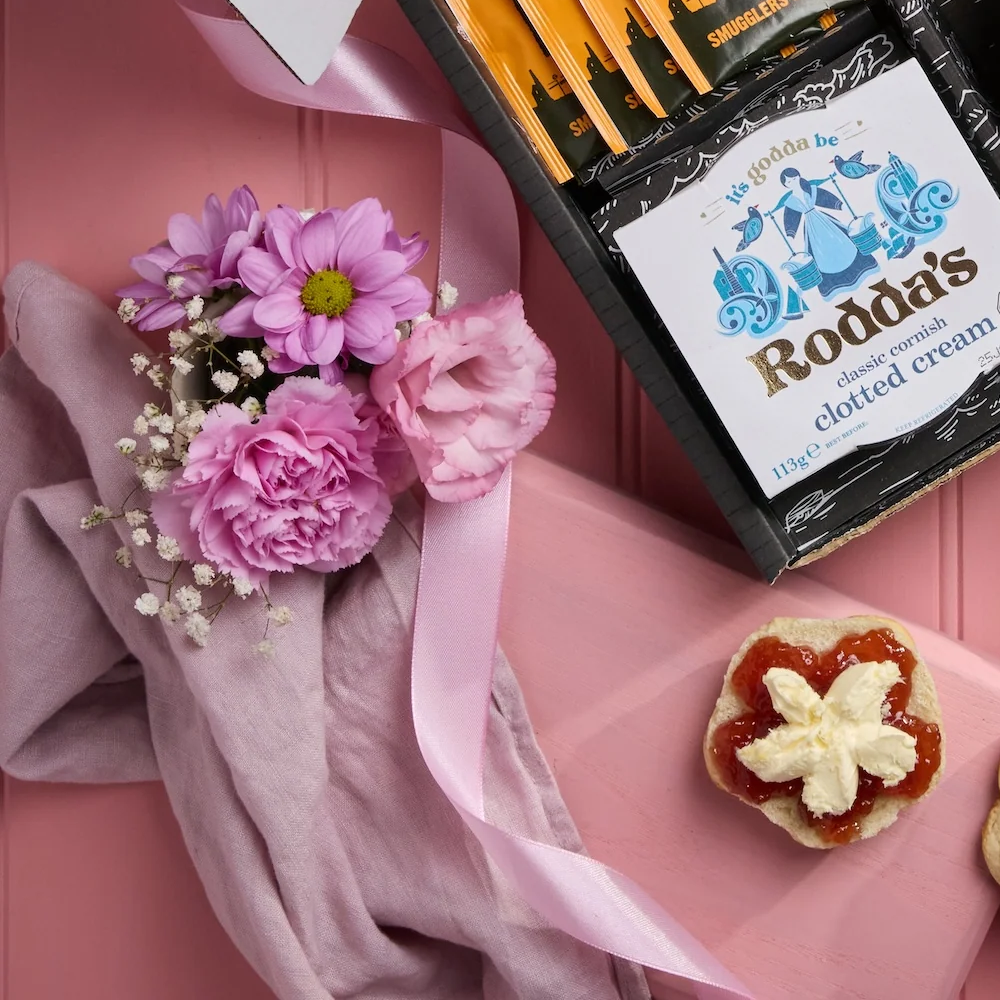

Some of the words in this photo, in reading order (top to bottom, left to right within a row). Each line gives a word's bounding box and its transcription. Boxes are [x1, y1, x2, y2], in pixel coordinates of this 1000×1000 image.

[725, 182, 749, 205] it's
[748, 138, 810, 186] godda
[814, 133, 839, 148] be
[746, 246, 978, 398] Rodda's
[837, 354, 887, 388] classic
[890, 317, 948, 356] cornish
[815, 363, 908, 431] clotted
[912, 318, 997, 373] cream
[825, 436, 842, 449] BEST
[895, 422, 912, 434] KEEP
[912, 392, 959, 426] REFRIGERATED
[772, 455, 809, 480] 113g
